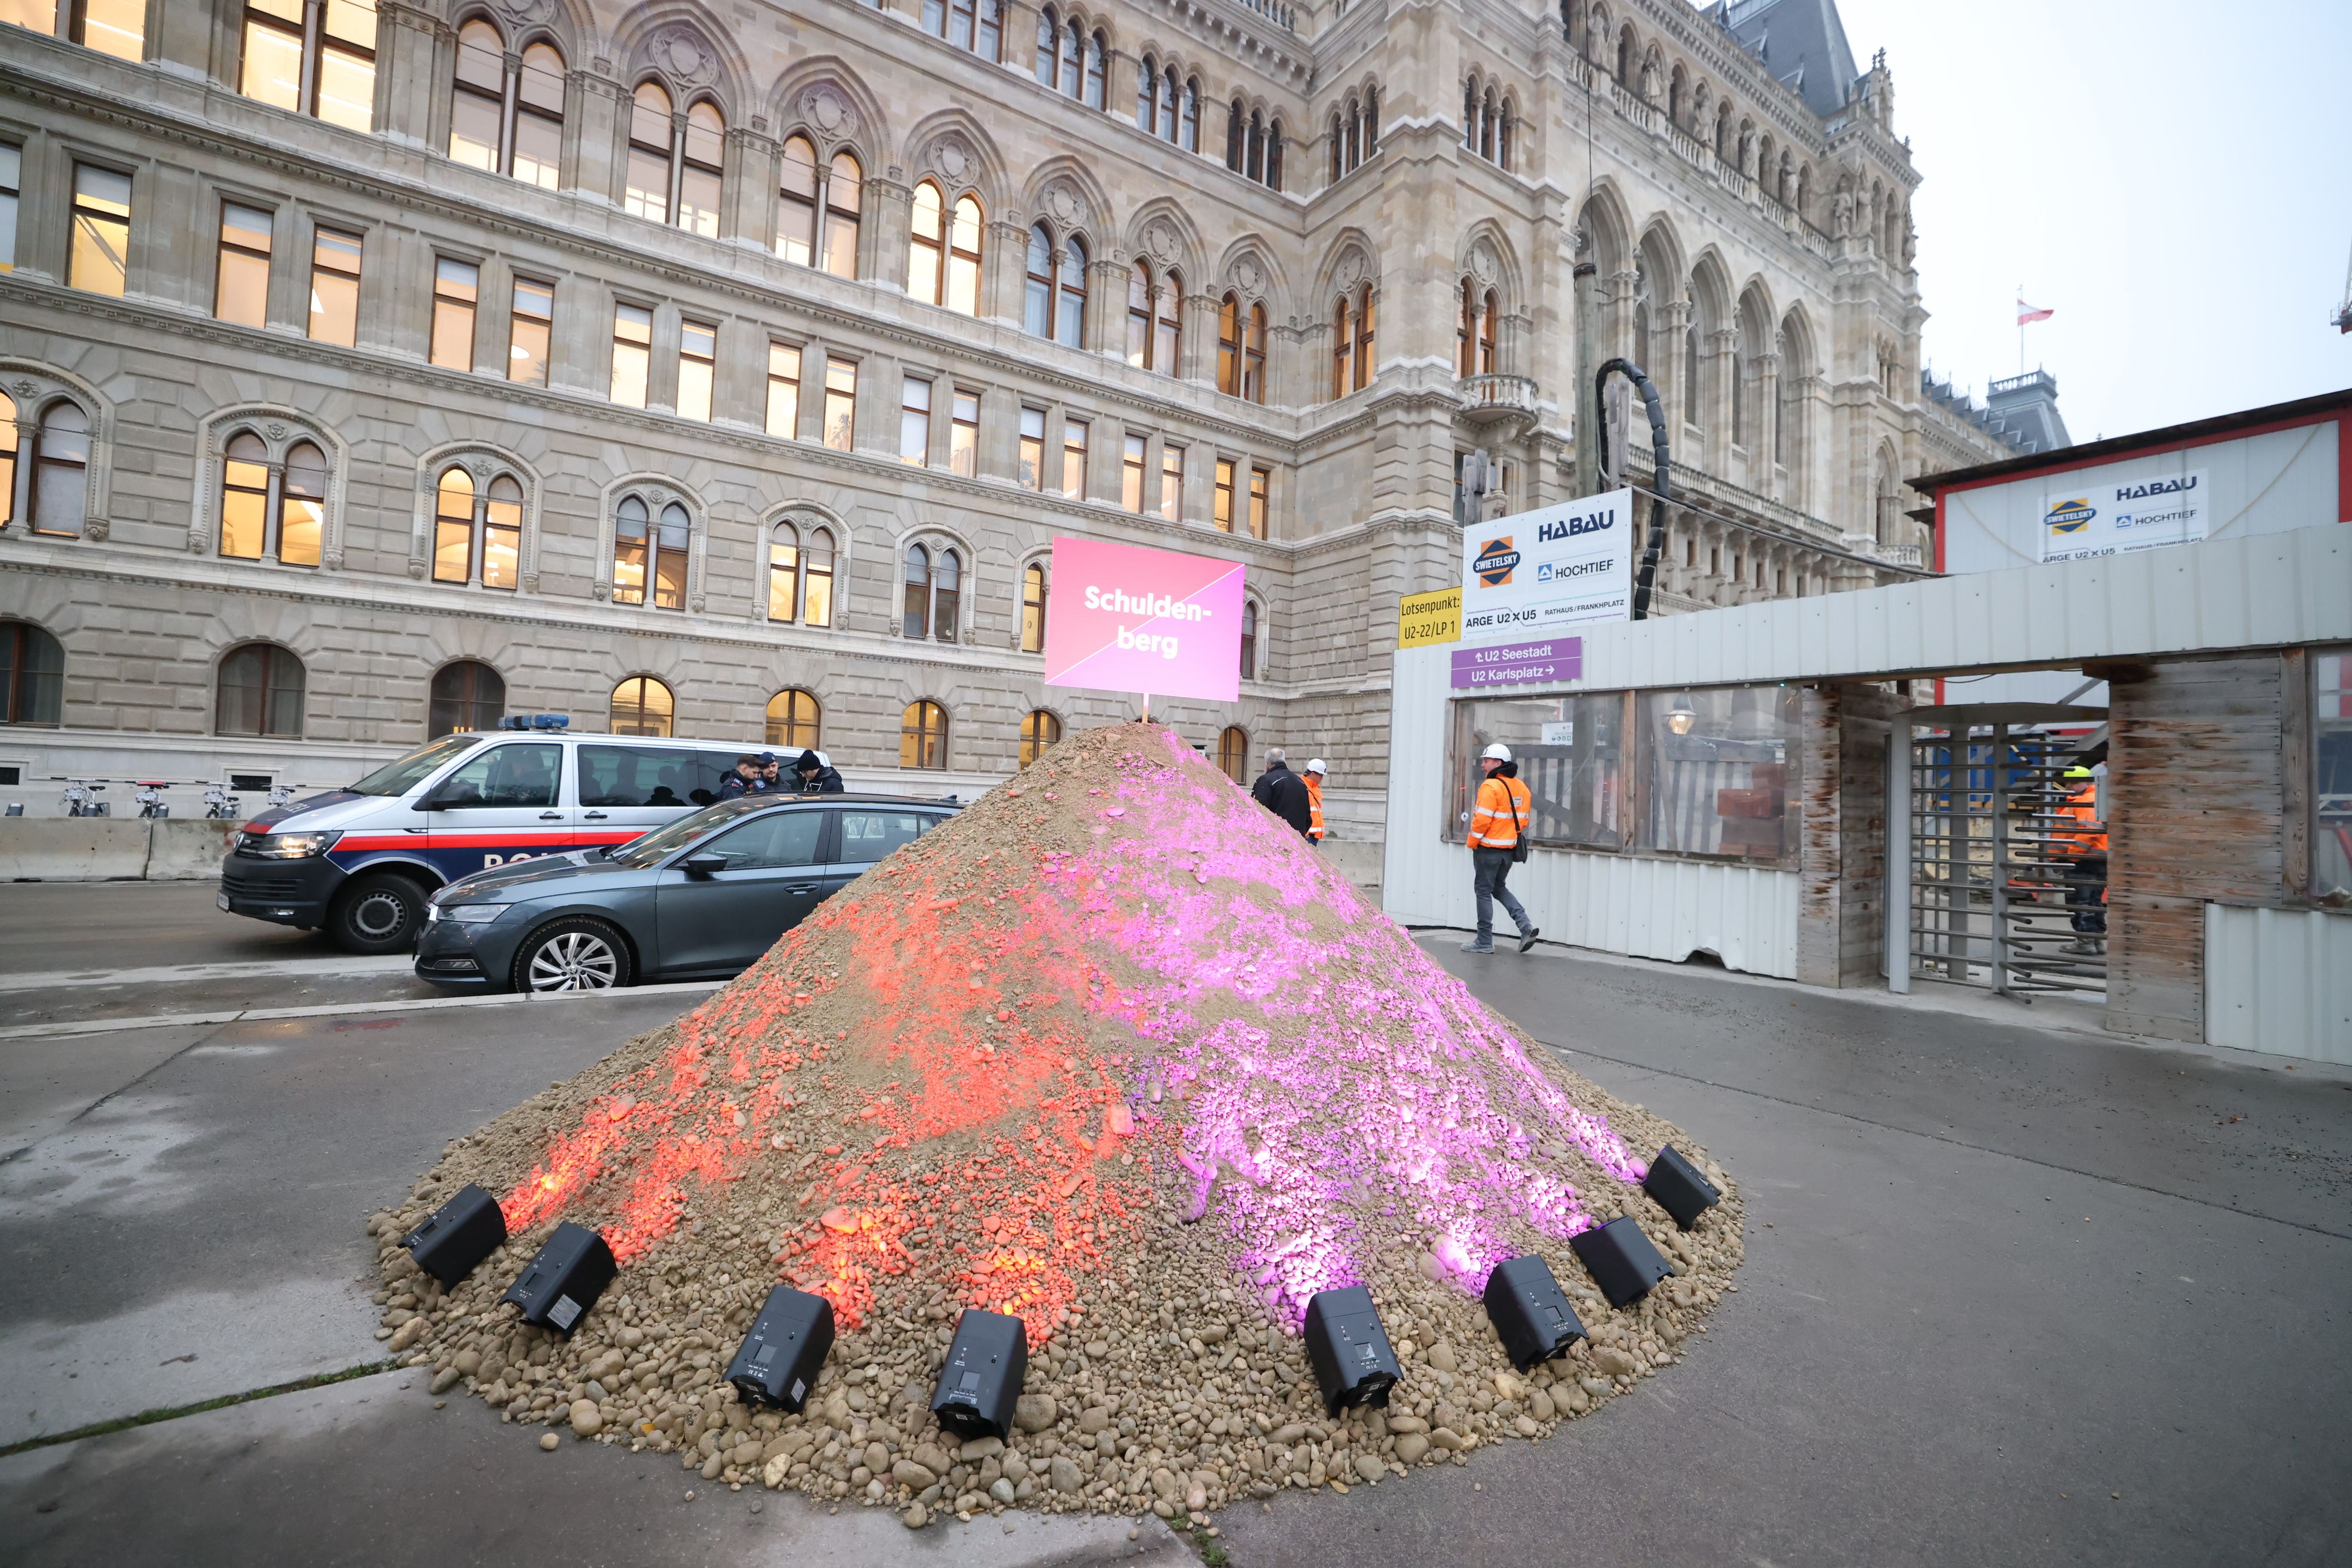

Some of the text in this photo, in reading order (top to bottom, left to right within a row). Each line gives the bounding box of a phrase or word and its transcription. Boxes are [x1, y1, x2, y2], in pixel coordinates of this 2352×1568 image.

[2117, 476, 2197, 502] HABAU
[2046, 509, 2094, 524] SWIETELSKY
[2136, 509, 2197, 526] HOCHTIEF
[1538, 509, 1614, 543] HABAU
[1475, 553, 1518, 571] SWIETELSKY
[2043, 554, 2070, 563] ARGE
[2076, 551, 2089, 559] U2
[1555, 559, 1614, 579] HOCHTIEF
[1084, 586, 1212, 621] Schulden-
[1401, 596, 1460, 616] Lotsenpunkt:
[1466, 616, 1493, 628] ARGE
[1497, 613, 1510, 624] U2
[1522, 610, 1536, 620] U5
[1405, 620, 1455, 639] U2-22/LP 1
[1117, 626, 1178, 660] berg
[1485, 644, 1552, 662] U2 Seestadt
[1471, 666, 1544, 682] U2 Karlsplatz
